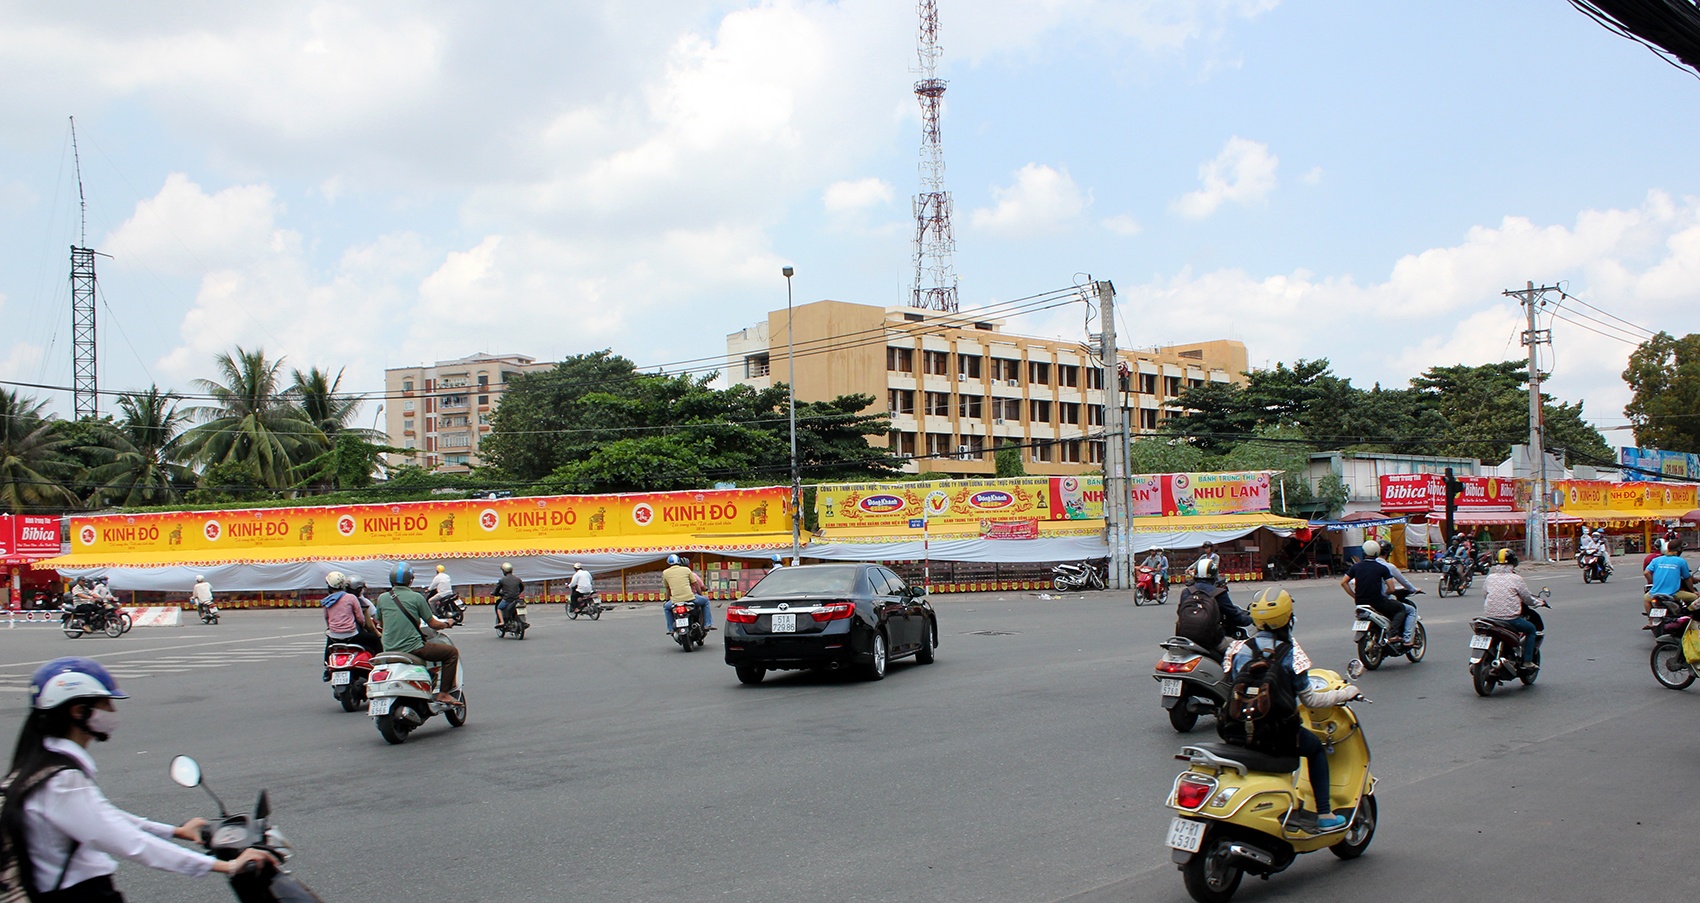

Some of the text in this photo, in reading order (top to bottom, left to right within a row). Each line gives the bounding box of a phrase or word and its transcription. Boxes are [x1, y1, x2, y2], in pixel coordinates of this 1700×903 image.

[1082, 490, 1104, 503] NH
[1193, 485, 1259, 499] NHƯ LAN
[1385, 484, 1427, 499] Bibica
[1465, 483, 1485, 497] Bibica
[1500, 483, 1514, 497] Bibic
[507, 512, 547, 527] KINH
[550, 507, 577, 526] ĐÔ
[663, 505, 706, 522] KINH
[709, 501, 737, 520] ĐÔ
[228, 523, 262, 537] KINH
[265, 518, 289, 536] ĐÔ
[363, 518, 400, 532] KINH
[403, 513, 428, 531] ĐÔ
[21, 527, 55, 541] Bibica
[103, 528, 135, 542] KINH
[138, 524, 159, 541] ĐÔ
[778, 616, 791, 624] 51A
[1174, 820, 1199, 836] 47-R1
[1171, 833, 1196, 849] 4530
